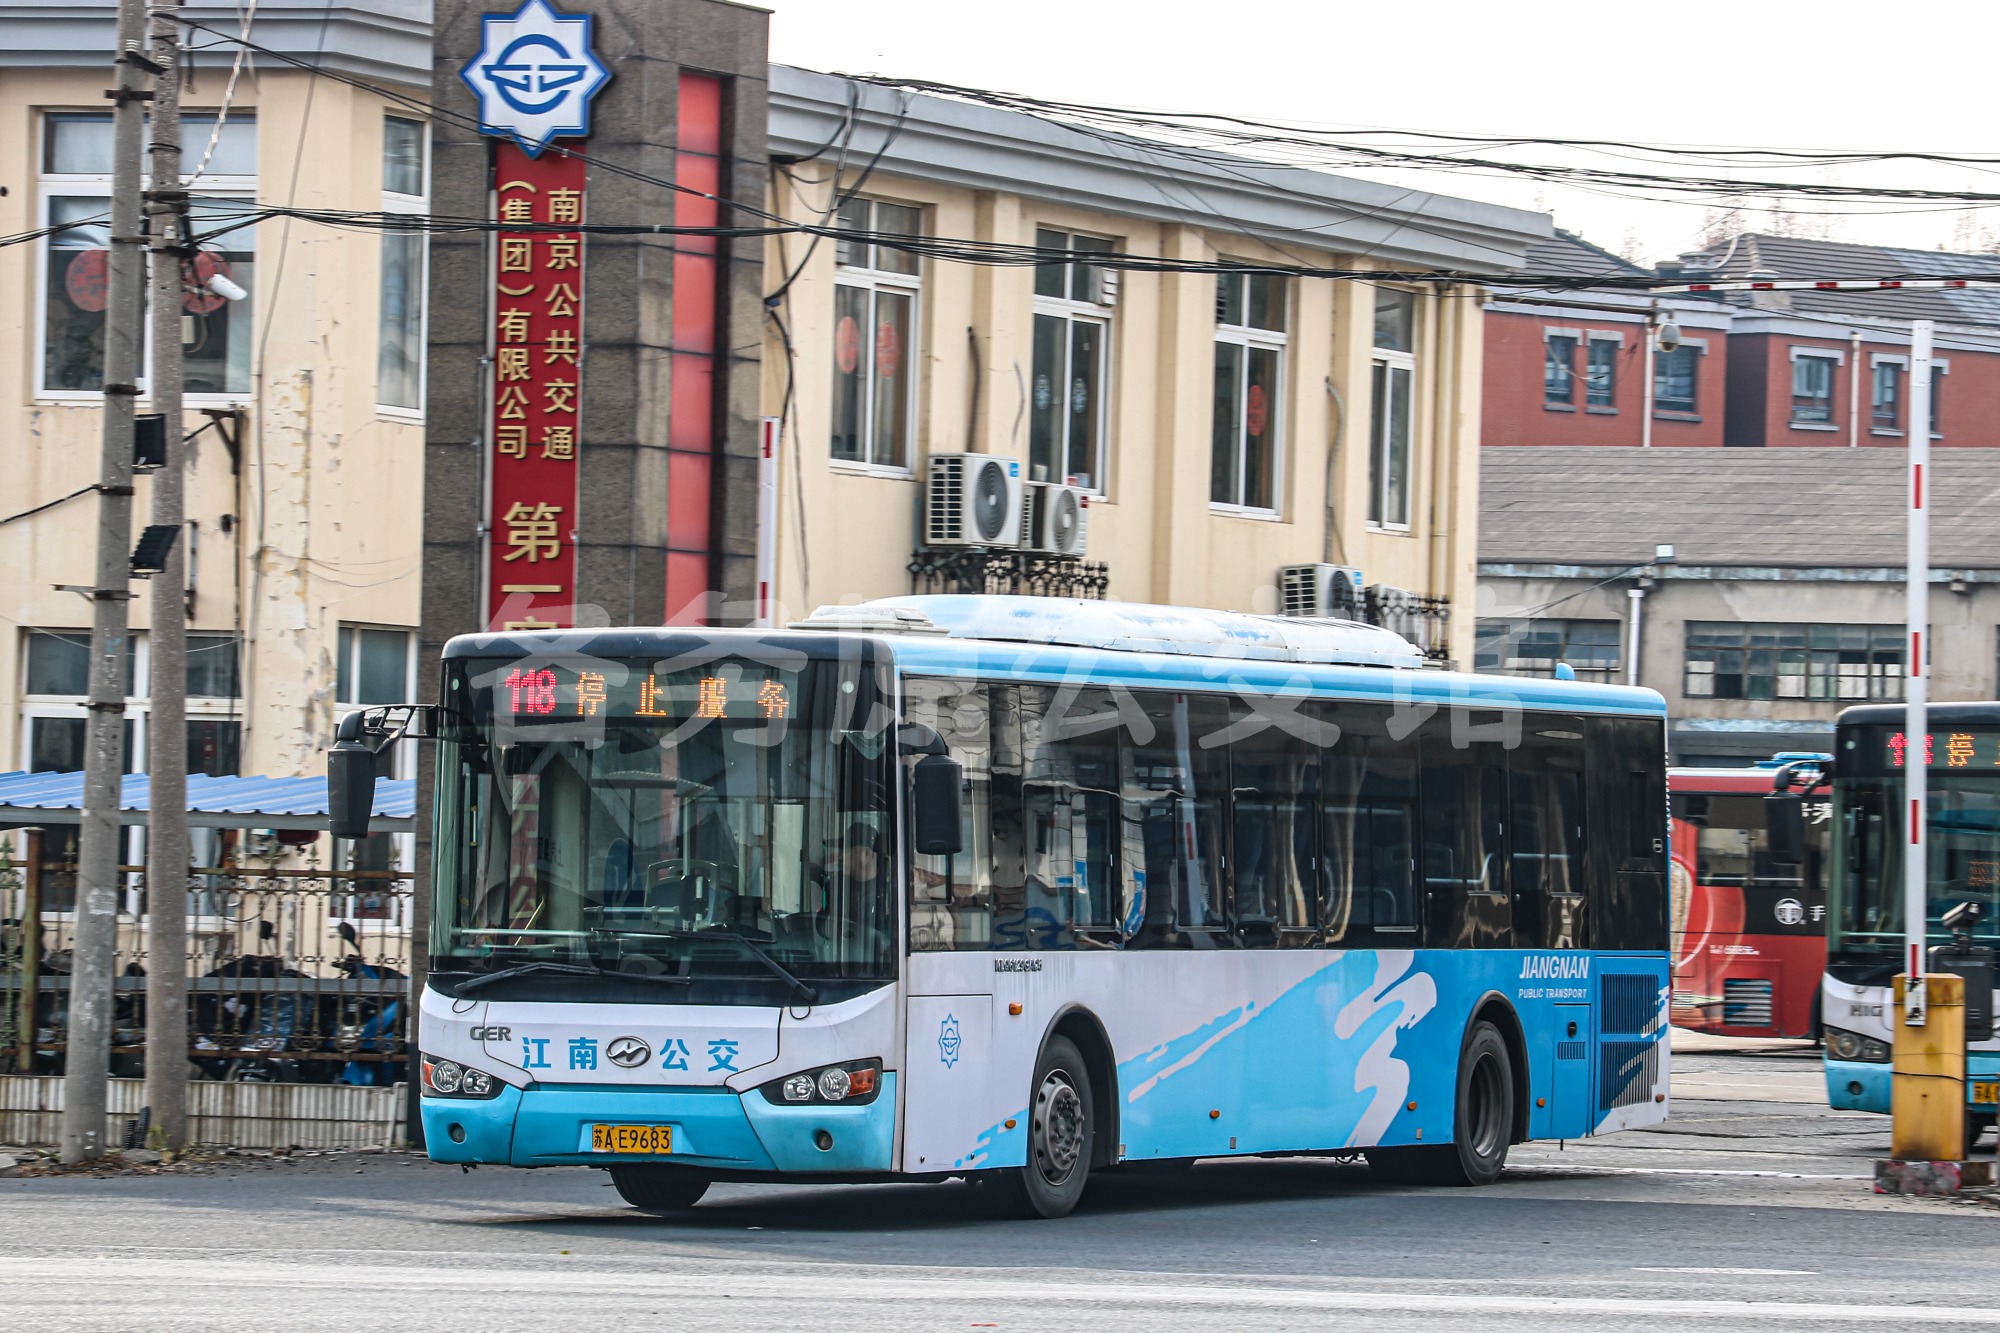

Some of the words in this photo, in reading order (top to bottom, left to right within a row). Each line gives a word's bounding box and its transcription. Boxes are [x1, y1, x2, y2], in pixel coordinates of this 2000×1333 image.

[540, 186, 582, 460] 南京公共交通
[501, 501, 563, 630] 第一
[504, 669, 557, 714] 118
[575, 671, 789, 719] 停止服务
[1519, 955, 1590, 979] JIANGNAN
[1518, 988, 1544, 999] PUBLIC
[1545, 988, 1588, 999] TRANSPORT
[469, 1025, 512, 1042] GER
